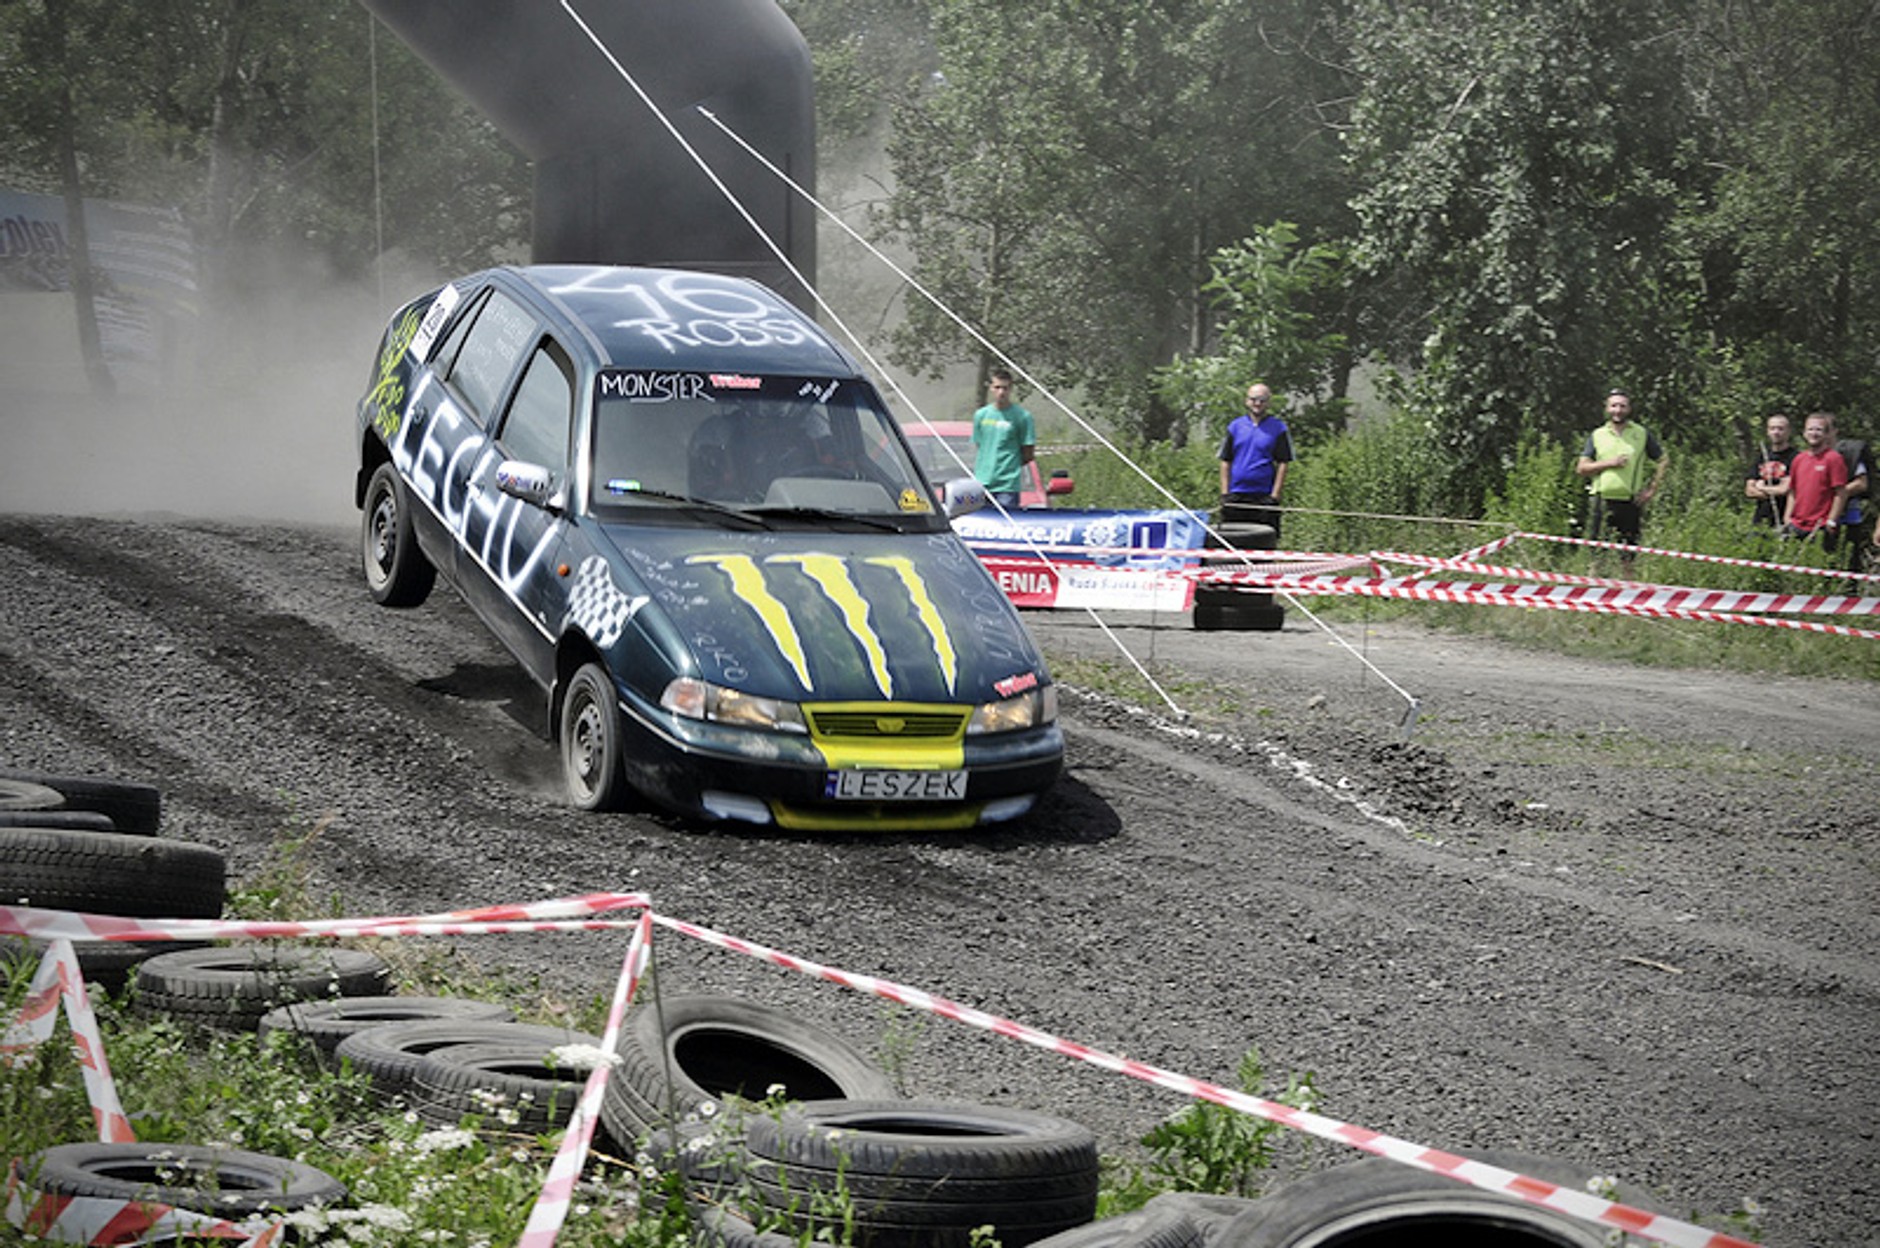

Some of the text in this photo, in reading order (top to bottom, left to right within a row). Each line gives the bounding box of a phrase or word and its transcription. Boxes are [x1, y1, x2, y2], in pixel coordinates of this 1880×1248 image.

[613, 317, 828, 355] ROSSI
[600, 371, 716, 403] MONSTER
[991, 570, 1054, 594] ENIA
[839, 771, 963, 798] LESZEK
